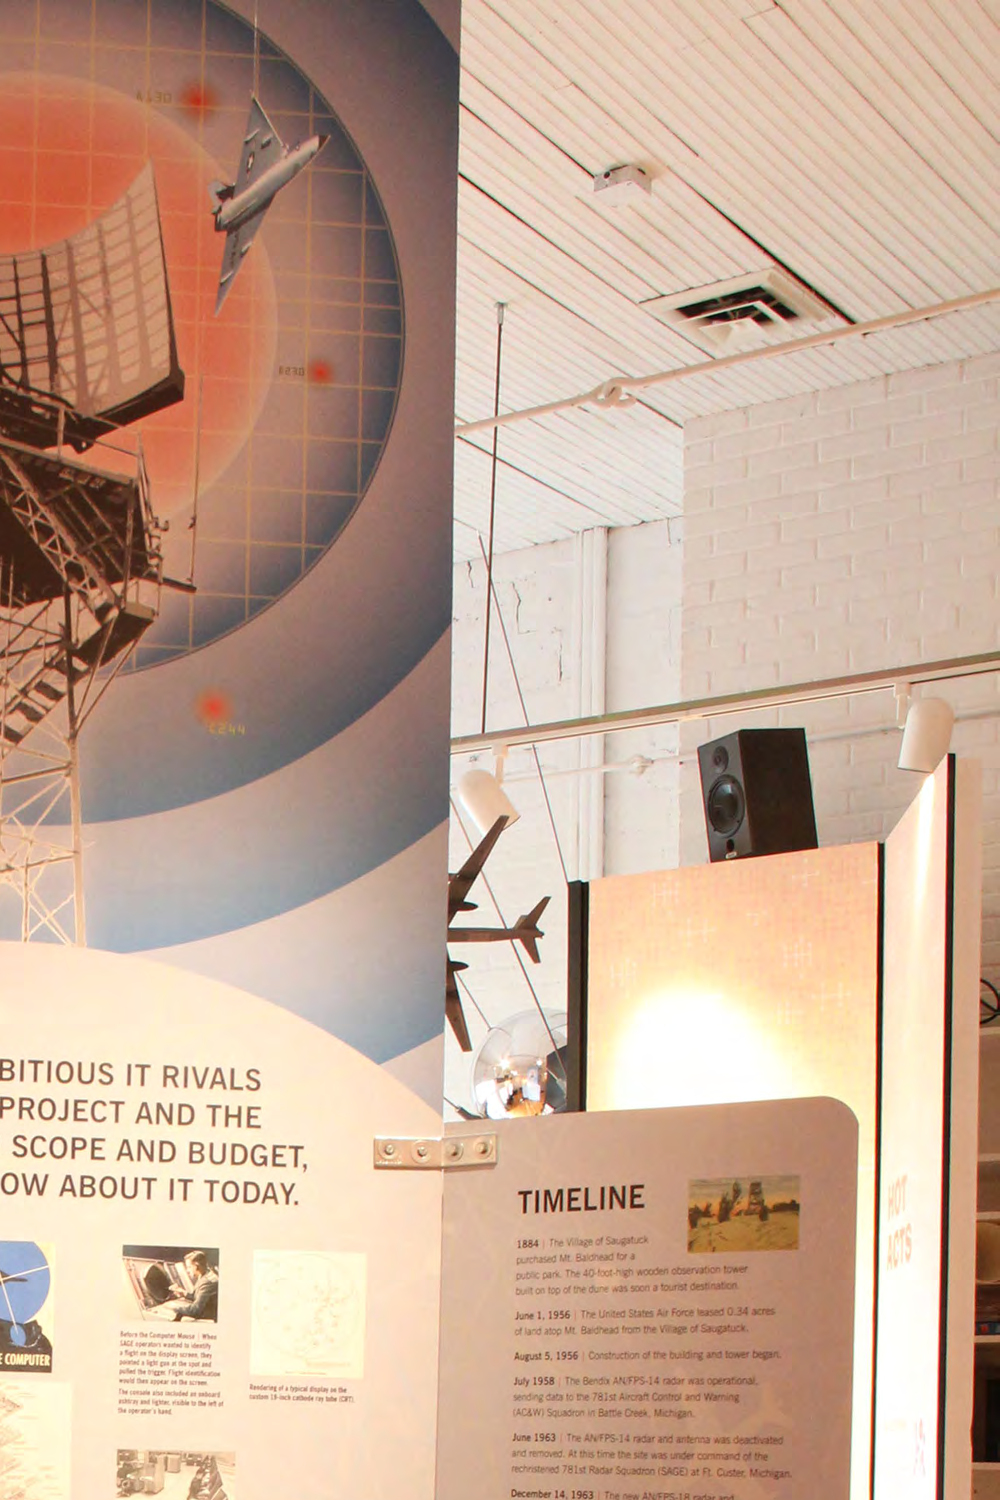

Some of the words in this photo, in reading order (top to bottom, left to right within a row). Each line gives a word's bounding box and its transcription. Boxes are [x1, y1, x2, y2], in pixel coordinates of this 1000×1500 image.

[127, 1063, 150, 1086] IT
[163, 1065, 260, 1091] RIVALS
[135, 1101, 195, 1125] AND
[206, 1104, 261, 1128] THE
[12, 1134, 105, 1160] SCOPE
[116, 1138, 176, 1162] AND
[189, 1141, 307, 1172] BUDGET,
[59, 1174, 157, 1200] ABOUT
[169, 1178, 193, 1201] IT
[204, 1179, 298, 1205] TODAY.
[518, 1184, 644, 1213] TIMELINE
[888, 1174, 908, 1221] HOT
[517, 1239, 539, 1249] 1884
[550, 1238, 564, 1247] The
[567, 1237, 593, 1248] Village
[595, 1236, 603, 1246] of
[605, 1235, 648, 1247] Saugatuck
[887, 1223, 912, 1271] ACTS
[514, 1311, 534, 1320] June
[548, 1309, 571, 1319] 1956
[581, 1309, 596, 1319] The
[598, 1309, 626, 1318] United
[628, 1308, 654, 1318] States
[656, 1308, 669, 1317] Air
[671, 1307, 694, 1317] Force
[696, 1308, 724, 1317] leased
[727, 1306, 749, 1316] 0.34
[751, 1307, 776, 1315] acres
[4, 1352, 50, 1367] COMPUTER
[513, 1376, 530, 1387] July
[533, 1376, 555, 1386] 1958
[565, 1376, 580, 1385] The
[582, 1376, 609, 1385] Bendix
[612, 1375, 660, 1385] AN/FPS-14
[663, 1376, 685, 1385] radar
[688, 1377, 704, 1385] was
